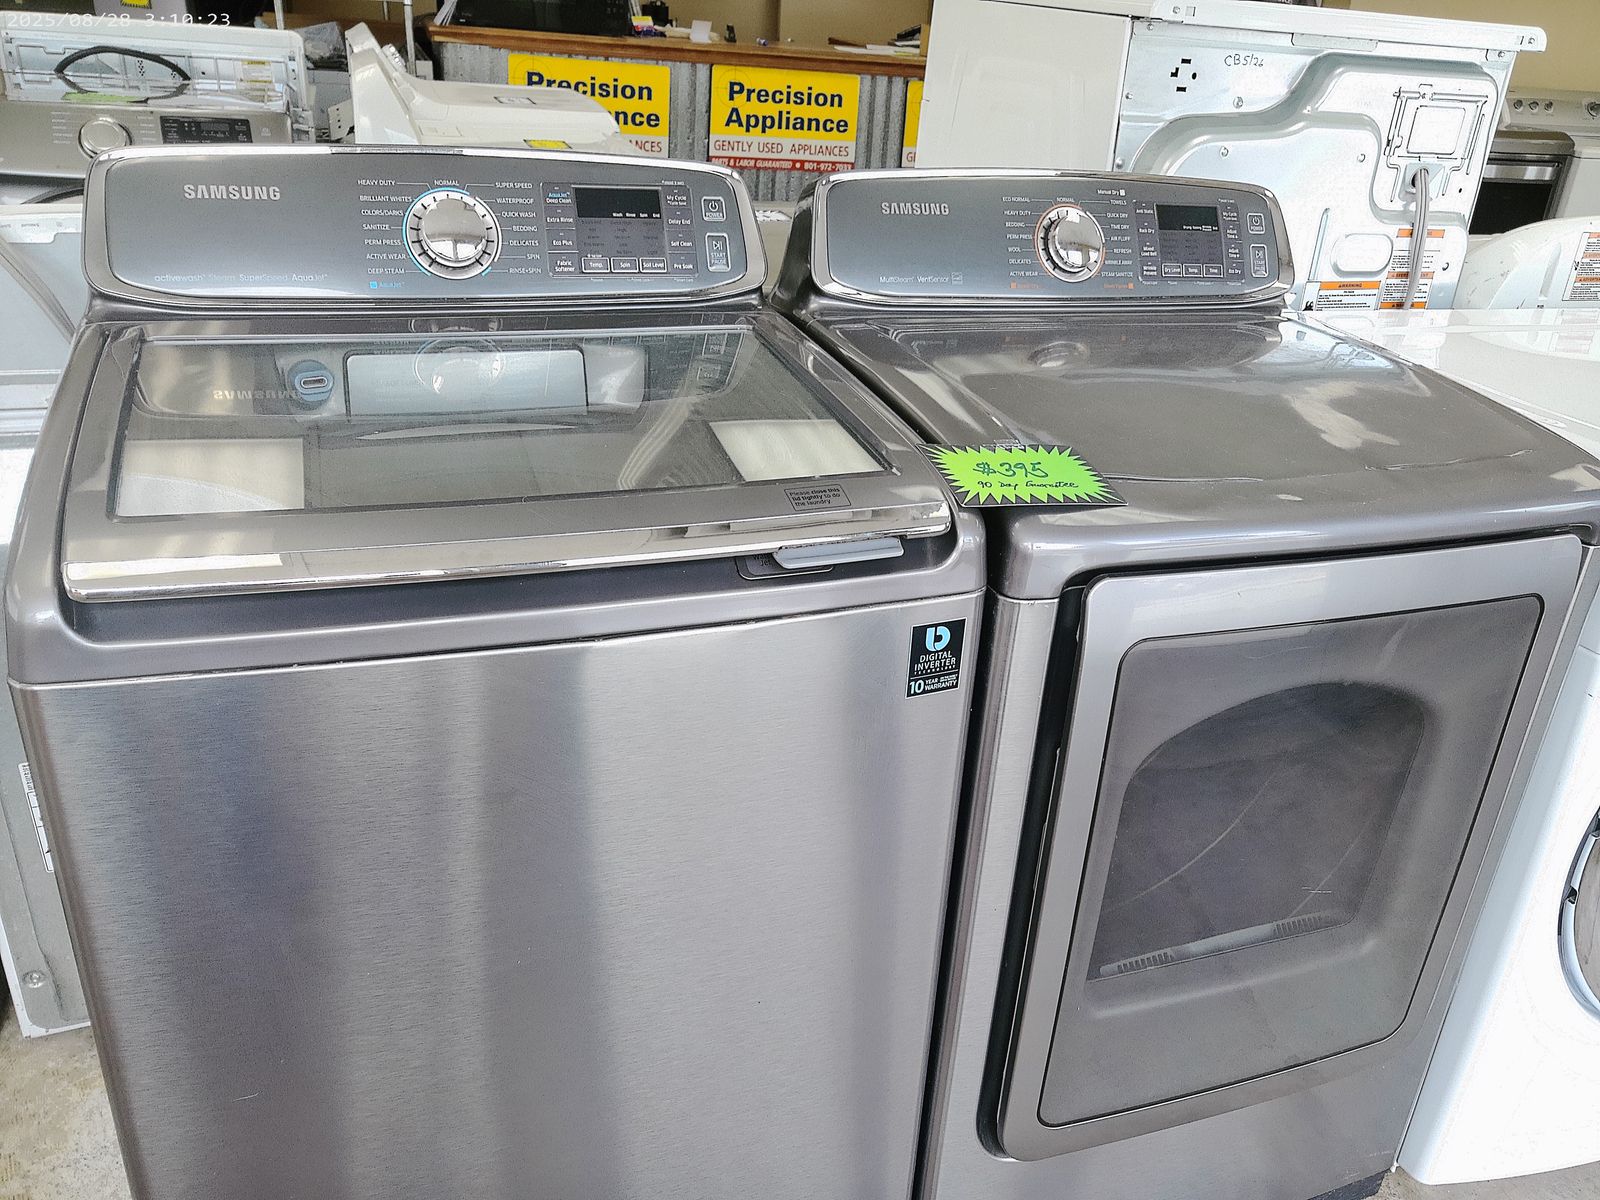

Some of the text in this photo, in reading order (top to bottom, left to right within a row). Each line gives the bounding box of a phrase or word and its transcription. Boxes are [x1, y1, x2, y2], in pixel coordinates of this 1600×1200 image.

[728, 81, 843, 108] Precision
[724, 107, 849, 134] Appliance
[714, 139, 849, 157] GENTLY USED APPLIANCES
[735, 159, 755, 167] LABOR
[756, 160, 792, 168] GUARANTEED
[184, 184, 281, 201] SAMSUNG
[546, 197, 557, 205] Deep
[881, 202, 949, 215] SAMSUNG
[668, 218, 681, 226] Delay
[972, 461, 1049, 479] $395
[977, 480, 993, 489] 90
[806, 498, 831, 506] laundry
[920, 651, 952, 662] DIGITAL
[914, 658, 956, 671] INVERTER
[909, 679, 925, 695] 10
[925, 677, 939, 685] YEAR
[924, 679, 958, 691] WARRANTY
